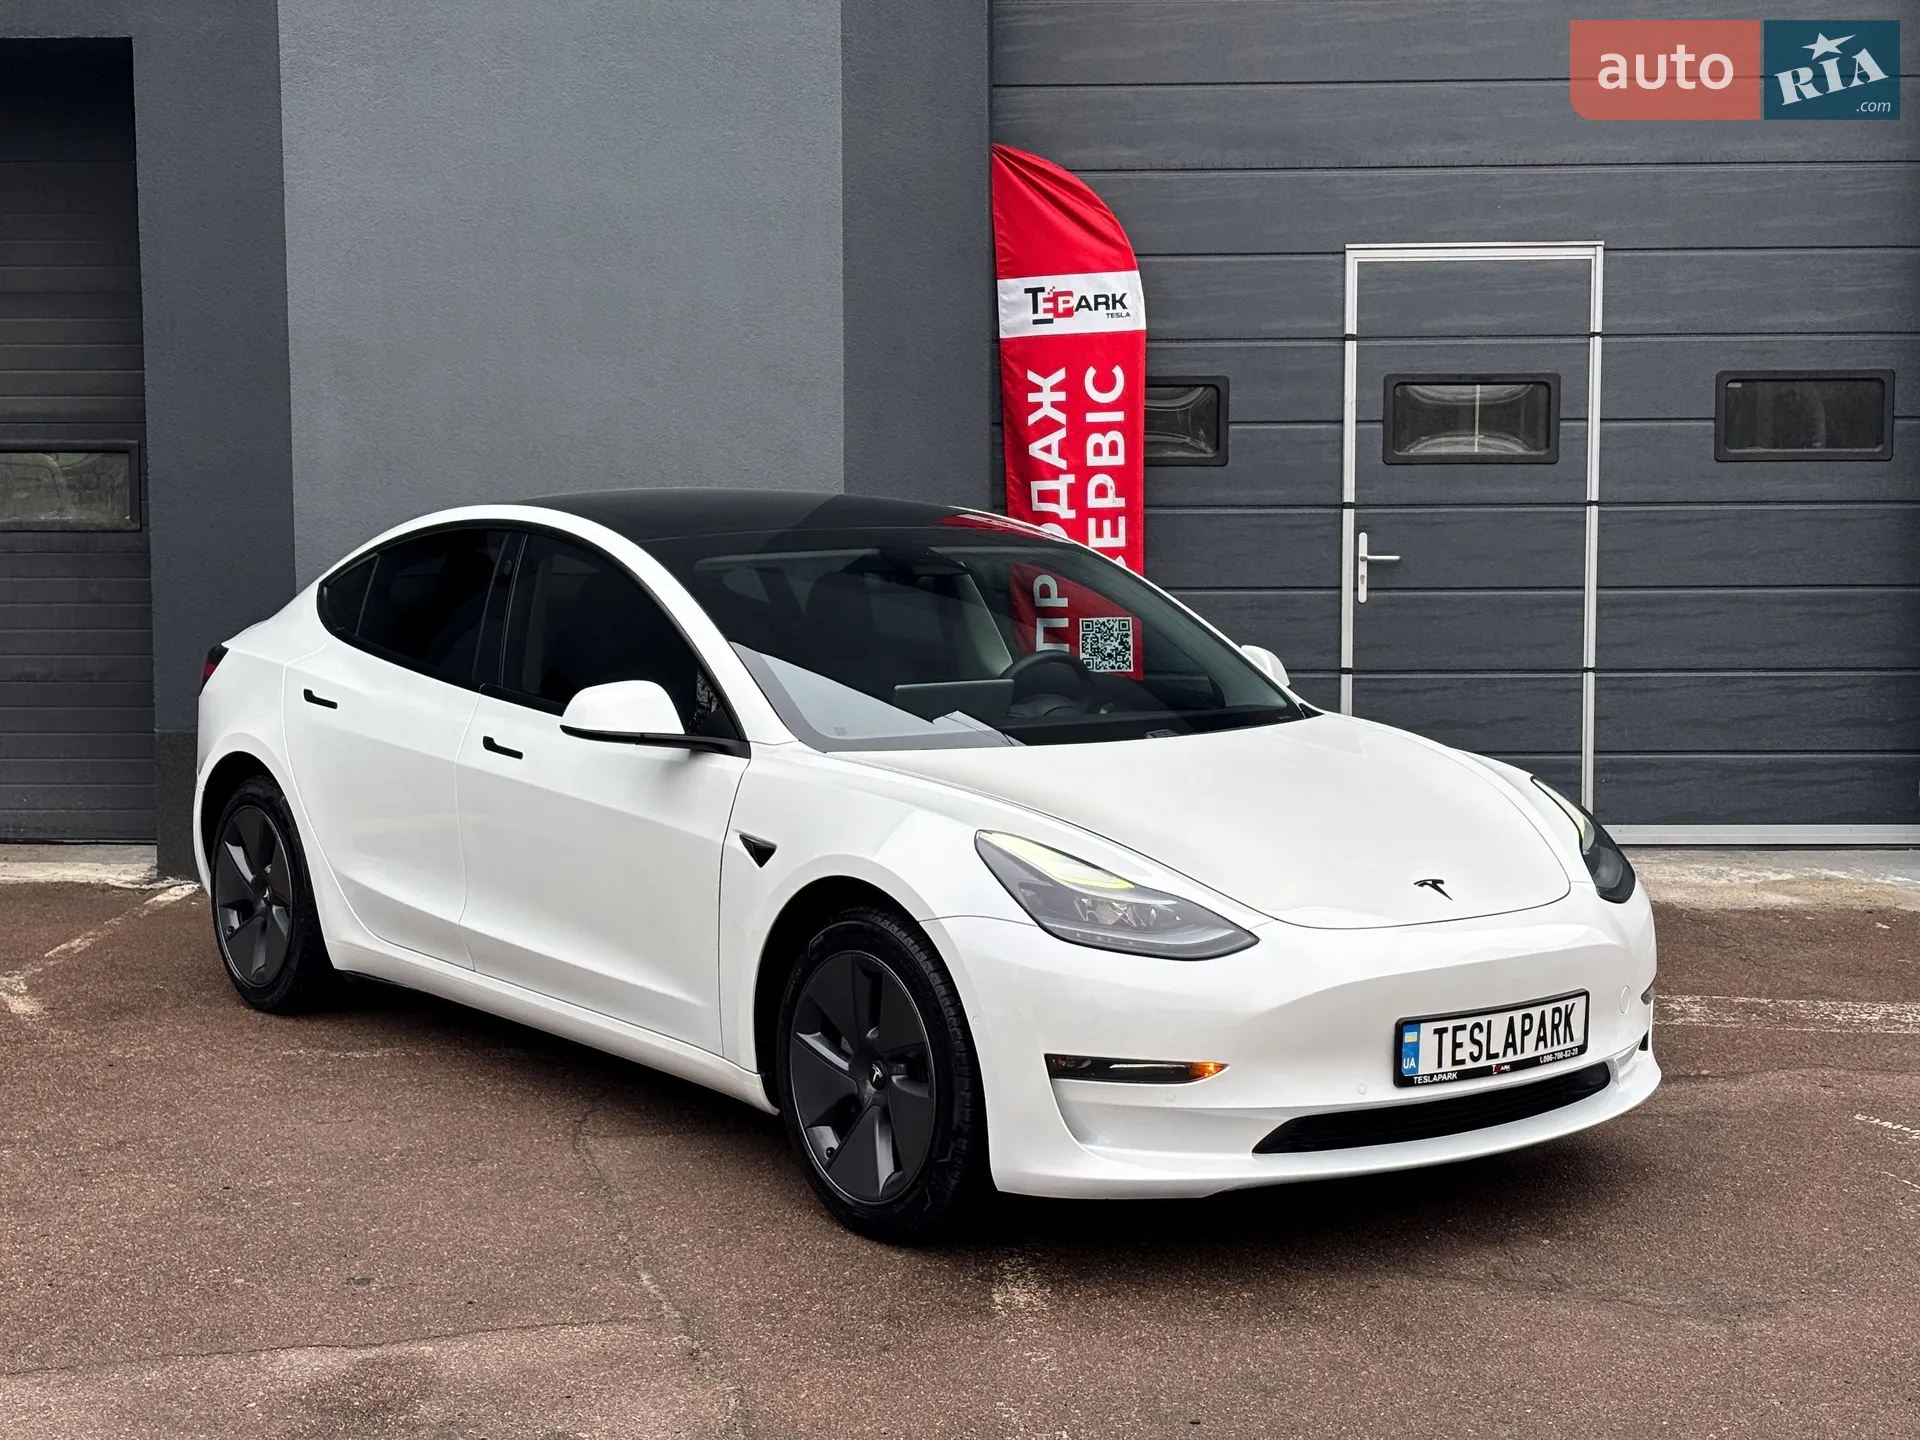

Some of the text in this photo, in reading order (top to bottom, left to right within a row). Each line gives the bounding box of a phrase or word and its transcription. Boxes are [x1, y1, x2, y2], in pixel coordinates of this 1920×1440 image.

[1084, 364, 1127, 568] ЕРВІС
[1027, 366, 1076, 652] ПРДАЖ
[1403, 1057, 1416, 1069] UA
[1433, 1002, 1576, 1069] TESLAPARK
[1413, 1072, 1458, 1084] TESLAPARK
